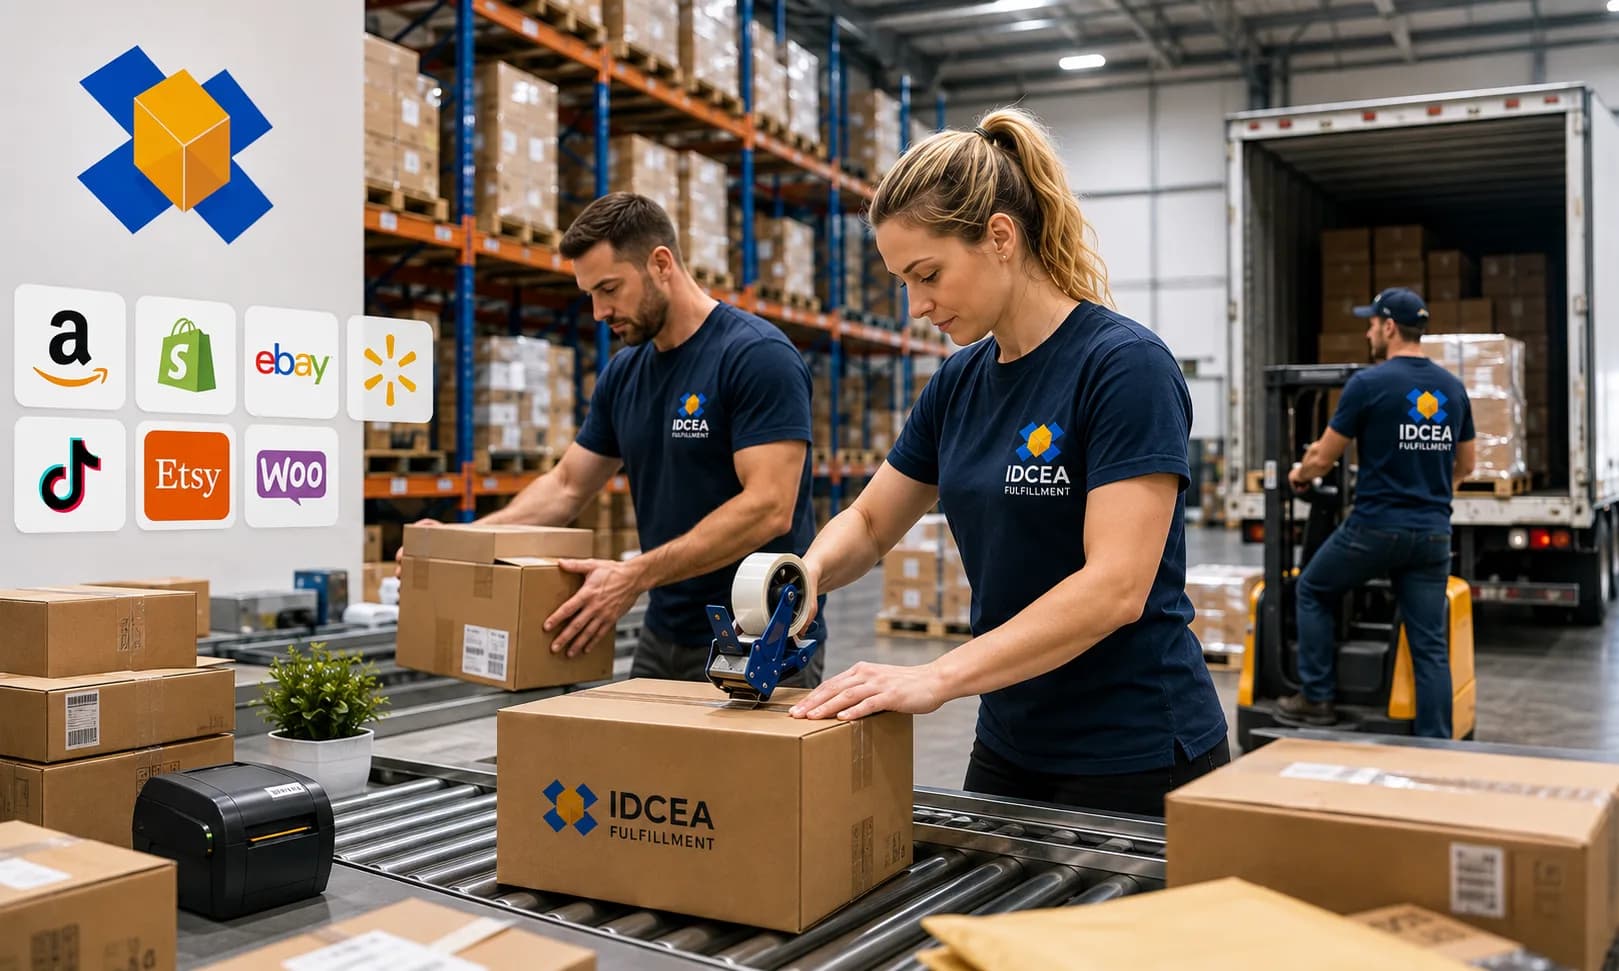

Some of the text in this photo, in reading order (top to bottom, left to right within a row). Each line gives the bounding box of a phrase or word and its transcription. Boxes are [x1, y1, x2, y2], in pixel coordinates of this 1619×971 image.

[255, 342, 329, 384] ebay
[672, 419, 709, 431] IDCEA
[1399, 423, 1453, 442] IDCEA
[1398, 441, 1453, 451] FULFILLMENT
[155, 458, 222, 498] Etsy
[1005, 465, 1071, 484] IDCEA
[1004, 485, 1071, 496] FULFILLMENT
[609, 790, 715, 830] IDCEA
[610, 825, 715, 851] FULFILLMENT
